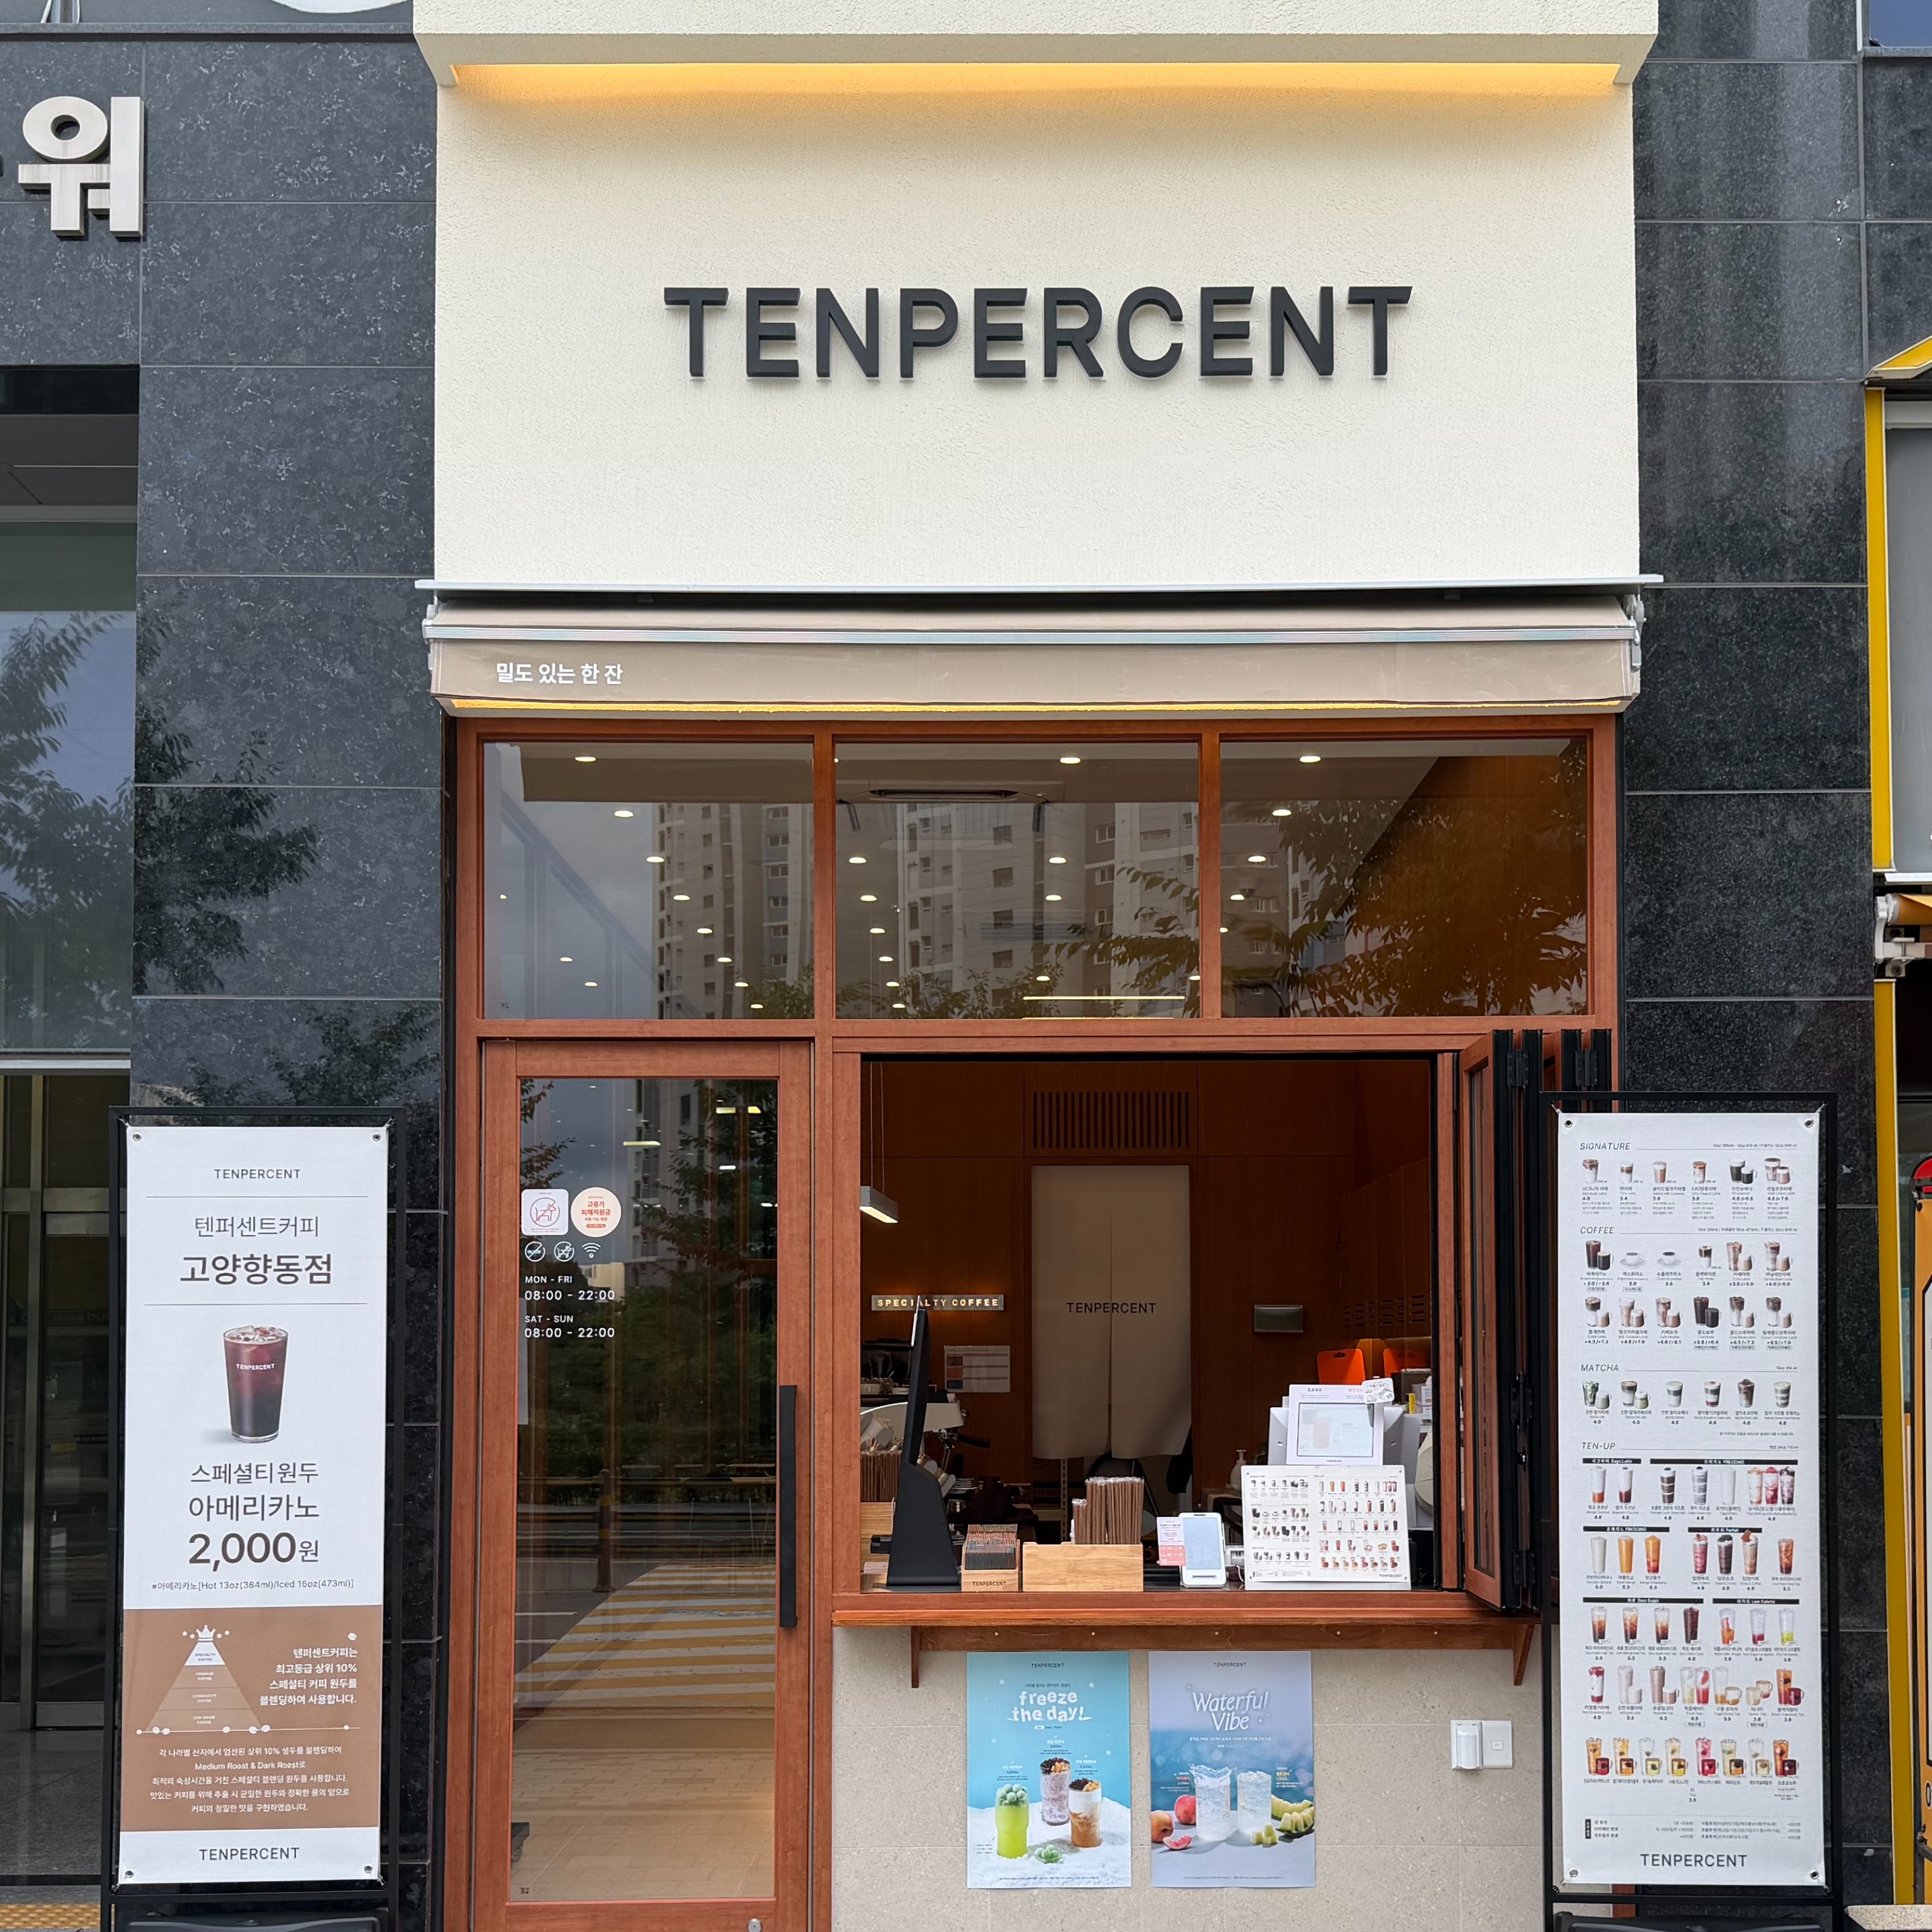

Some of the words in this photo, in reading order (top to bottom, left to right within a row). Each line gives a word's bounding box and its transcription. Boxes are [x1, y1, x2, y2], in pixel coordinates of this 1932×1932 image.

[663, 285, 1412, 379] TENPERCENT
[496, 662, 533, 683] 밀도
[538, 663, 576, 684] 있는
[581, 663, 600, 684] 한
[604, 663, 623, 684] 잔
[1580, 1142, 1631, 1150] SIGNATURE
[214, 1168, 301, 1180] TENPERCENT
[194, 1216, 319, 1239] 텐퍼센트커피
[1580, 1226, 1615, 1234] COFFEE
[180, 1253, 333, 1286] 고양향동점
[525, 1276, 547, 1284] MON
[524, 1290, 562, 1301] 08:00
[578, 1290, 615, 1300] 22:00
[1066, 1302, 1157, 1314] TENPERCENT
[524, 1328, 562, 1338] 08:00
[578, 1328, 615, 1338] 22:00
[1581, 1364, 1619, 1372] MATCHA
[189, 1495, 320, 1521] 아메리카노
[189, 1532, 319, 1572] 2,000원
[293, 1647, 358, 1659] 텐퍼센트커피는
[275, 1663, 313, 1675] 최고등급
[315, 1663, 334, 1674] 상위
[336, 1663, 358, 1673] 10%
[269, 1678, 306, 1690] 스페셜티
[308, 1678, 327, 1689] 커피
[329, 1678, 358, 1689] 원두를
[259, 1694, 306, 1706] 블렌딩하여
[308, 1694, 357, 1704] 사용합니다.
[1019, 1691, 1078, 1706] freeze
[1192, 1690, 1269, 1715] Waterful
[1012, 1706, 1044, 1722] the
[1047, 1705, 1084, 1722] day!
[1211, 1711, 1249, 1731] Vibe
[264, 1747, 280, 1755] 10%
[199, 1847, 301, 1861] TENPERCENT
[1640, 1853, 1748, 1867] TENPERCENT
